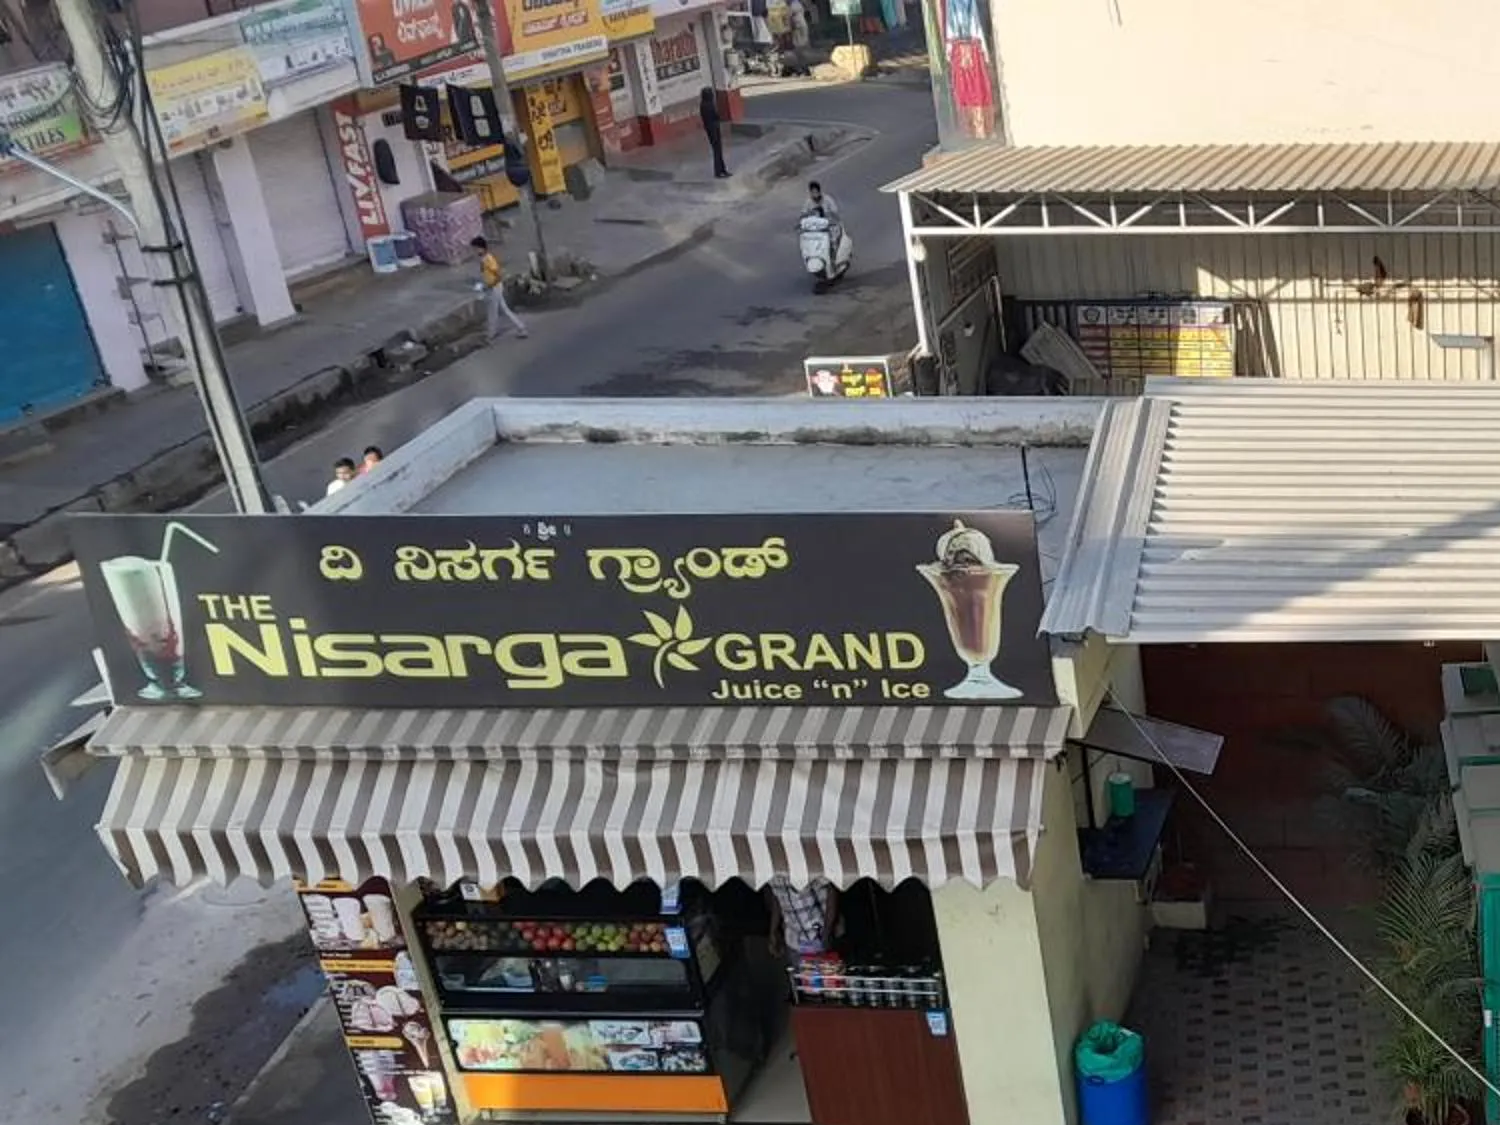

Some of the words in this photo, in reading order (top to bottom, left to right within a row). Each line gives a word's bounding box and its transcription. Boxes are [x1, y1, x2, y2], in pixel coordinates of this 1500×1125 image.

[319, 545, 363, 580] ದಿ
[394, 538, 555, 581] ನಿಸರ್ಗ
[197, 594, 277, 621] THE
[204, 617, 629, 690] Nisarga
[714, 632, 926, 671] GRAND
[711, 679, 803, 699] Juice
[881, 679, 931, 698] Ice
